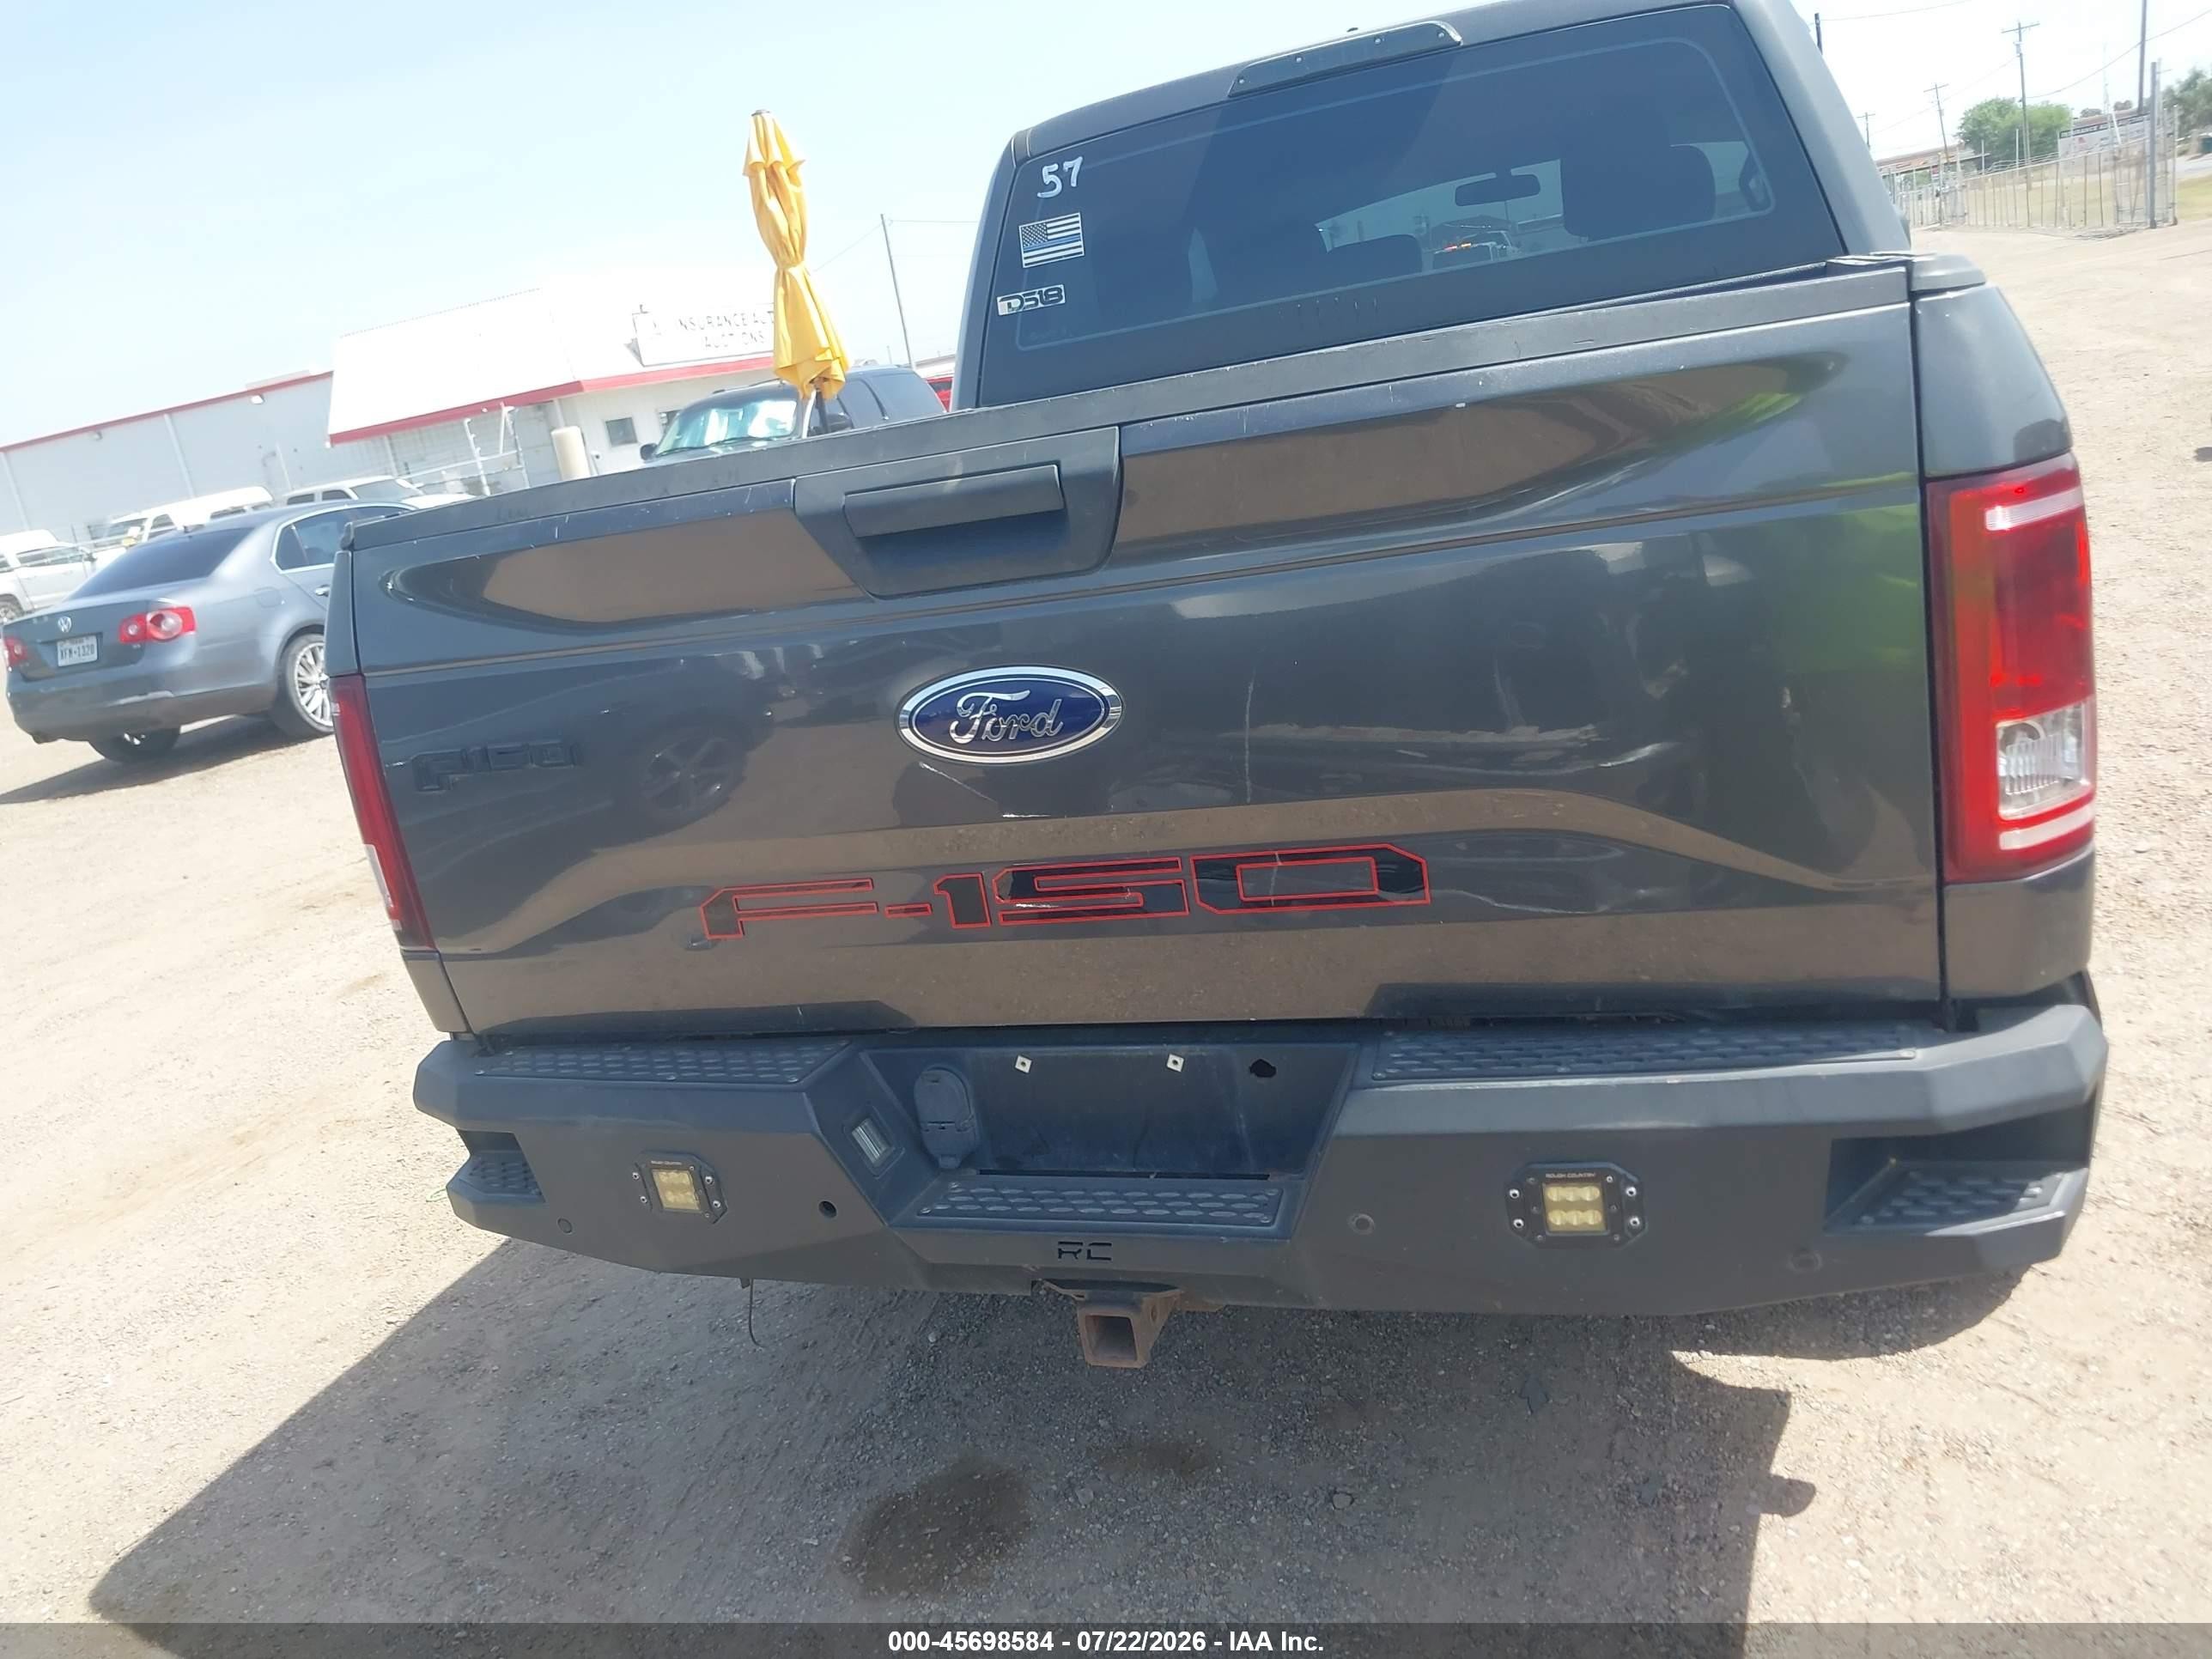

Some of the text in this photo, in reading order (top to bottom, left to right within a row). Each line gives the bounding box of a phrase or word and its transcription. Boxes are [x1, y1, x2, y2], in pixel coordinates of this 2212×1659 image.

[1037, 156, 1082, 198] 57
[949, 690, 1064, 744] Ford
[700, 842, 1431, 940] F-150
[1058, 1241, 1112, 1261] RC
